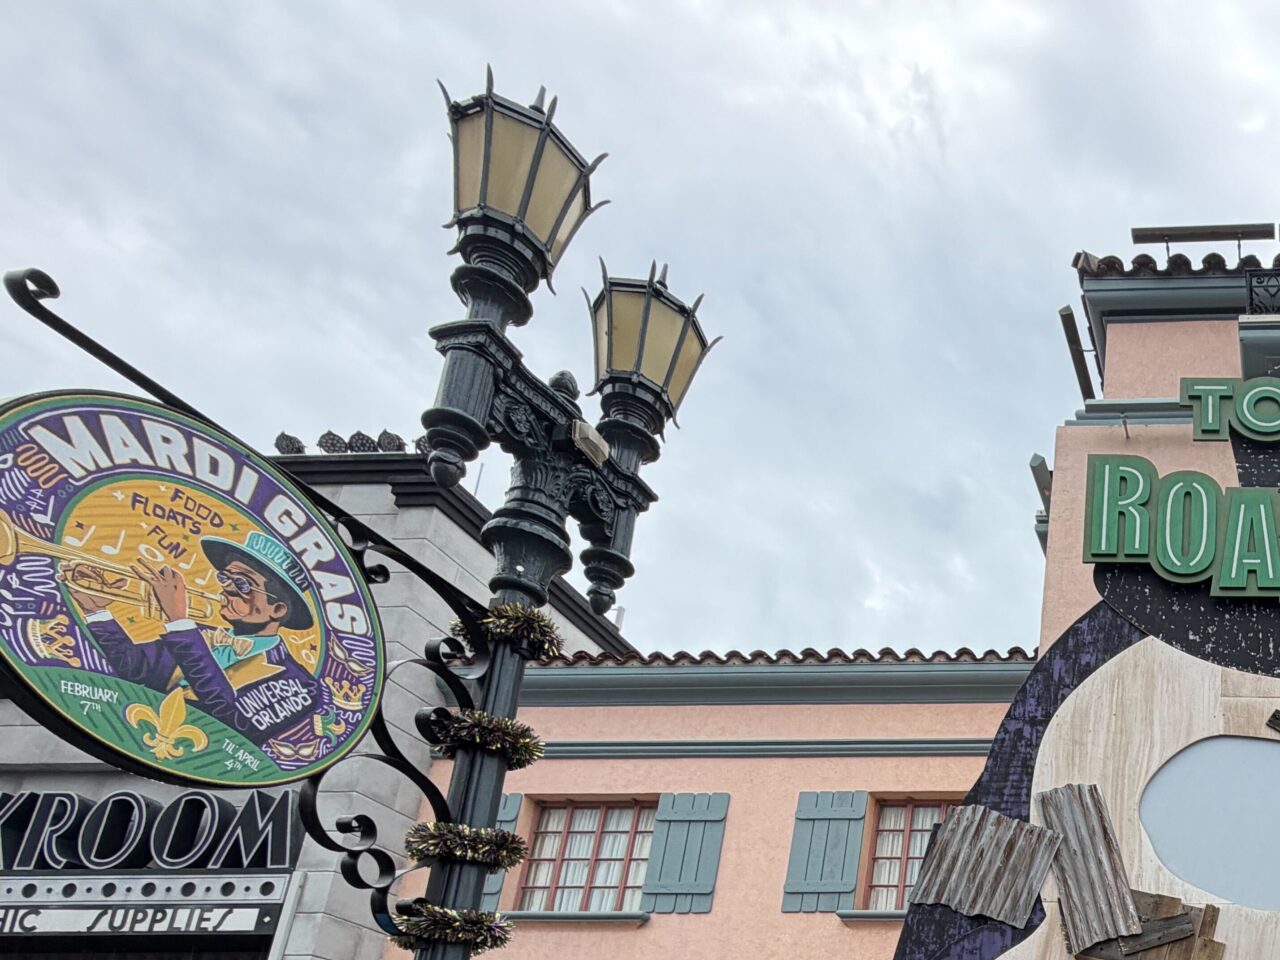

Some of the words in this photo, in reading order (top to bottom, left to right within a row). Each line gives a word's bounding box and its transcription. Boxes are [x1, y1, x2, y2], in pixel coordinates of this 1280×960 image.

[27, 413, 259, 505] MARDI
[263, 494, 370, 635] GRAS
[130, 491, 203, 535] FLOATS
[170, 487, 224, 528] FOOD
[146, 525, 188, 559] FUN
[60, 680, 119, 704] FEBRUARY
[79, 700, 102, 716] 7TH
[235, 678, 308, 718] UNIVERSAL
[251, 694, 313, 732] ORLANDO
[223, 759, 243, 772] 4TH
[234, 749, 261, 772] APRIL
[87, 908, 234, 933] SUPPLIES
